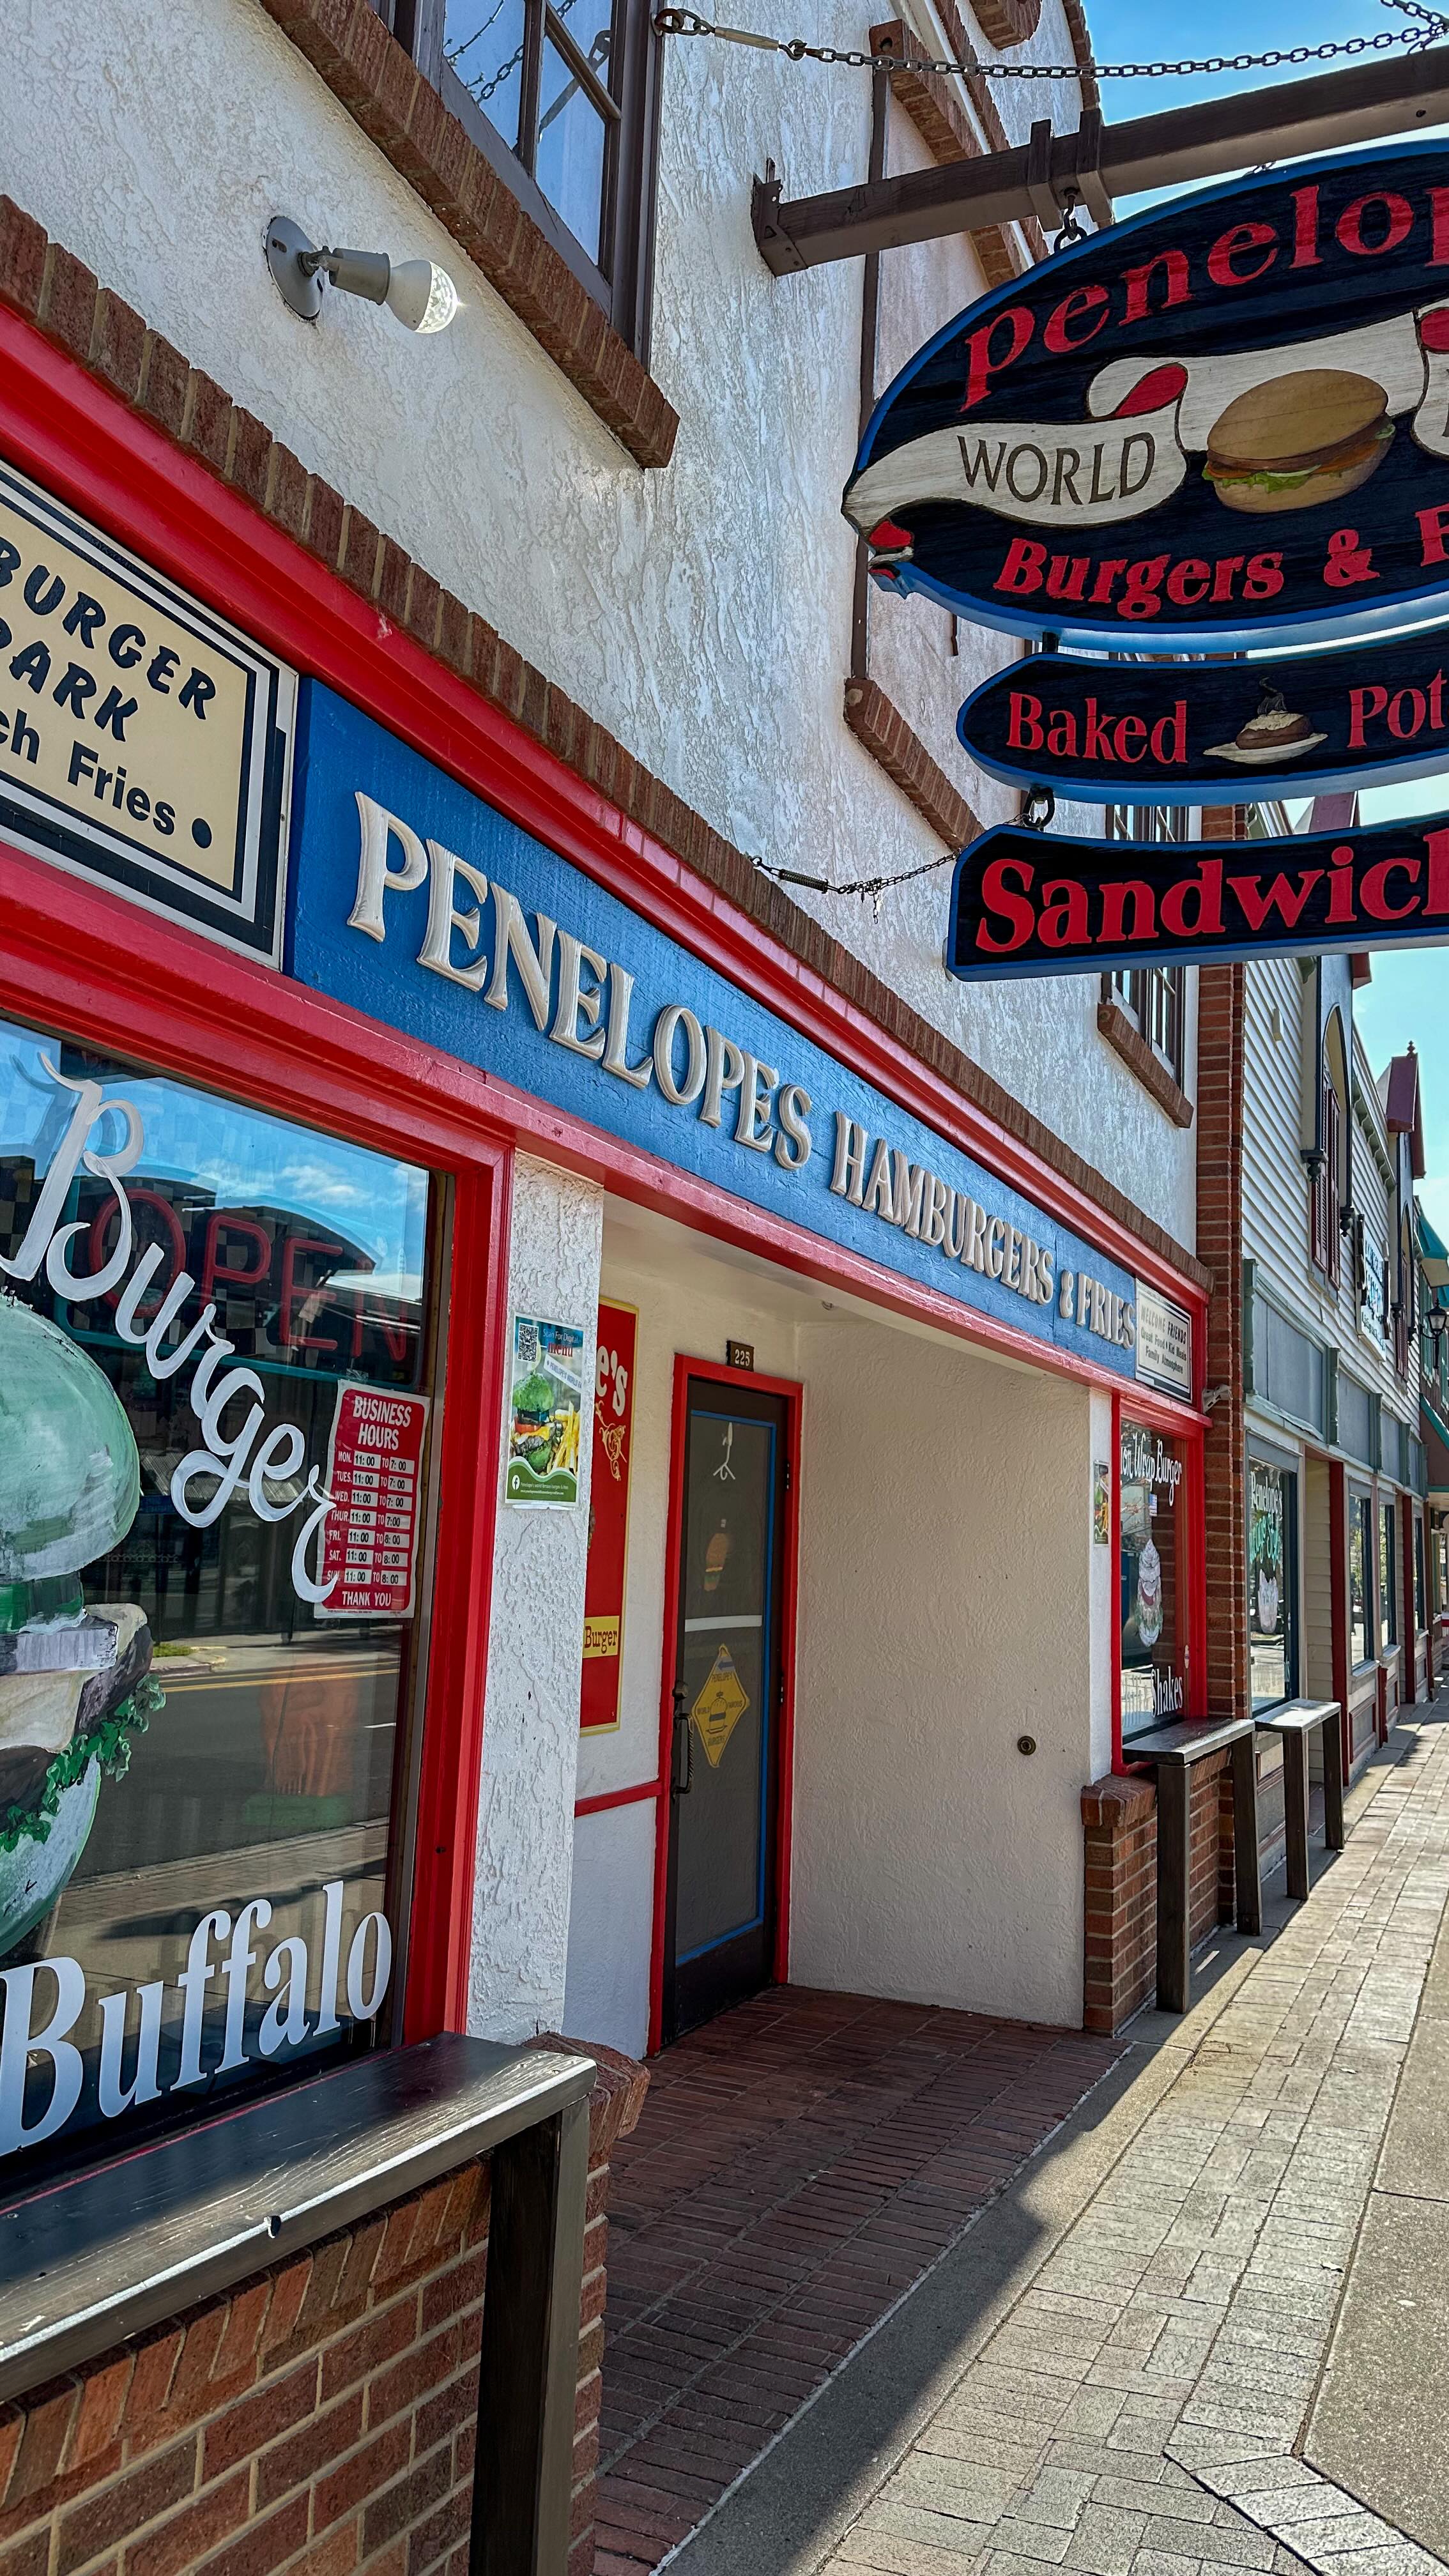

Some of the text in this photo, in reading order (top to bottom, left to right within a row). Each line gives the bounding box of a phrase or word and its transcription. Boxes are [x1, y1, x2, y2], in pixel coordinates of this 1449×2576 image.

[957, 433, 1154, 507] WORLD
[994, 537, 1284, 620] Burgers
[1323, 529, 1381, 587] &
[0, 537, 217, 720] BURGER
[1007, 669, 1447, 763] Baked Pot
[68, 740, 176, 836] Fries
[347, 791, 813, 1171] PENELOPES
[830, 1111, 1053, 1305] HAMBURGERS
[1076, 1272, 1135, 1349] FRIES
[0, 1052, 337, 1604] Burger
[564, 1333, 578, 1344] Digital
[1141, 1305, 1186, 1344] WELCOME FRIENDS
[1141, 1327, 1153, 1343] Great
[1155, 1334, 1165, 1349] Food
[735, 1349, 750, 1367] 225
[1146, 1346, 1160, 1364] Family
[595, 1346, 628, 1416] e's
[353, 1395, 411, 1427] BUSINESS
[358, 1423, 399, 1450] HOURS
[338, 1451, 351, 1462] MON.
[382, 1457, 388, 1468] TO
[1133, 1432, 1155, 1492] Wrap
[1155, 1439, 1182, 1506] Burger
[337, 1471, 352, 1482] TUES.
[380, 1476, 387, 1487] TO
[335, 1491, 349, 1502] WED.
[379, 1496, 386, 1506] TO
[331, 1510, 349, 1521] THUR.
[378, 1515, 384, 1524] TO
[328, 1530, 341, 1541] FRI.
[376, 1533, 383, 1544] TO
[329, 1550, 341, 1561] SAT.
[374, 1553, 381, 1563] TO
[373, 1572, 379, 1582] TO
[342, 1591, 391, 1606] THANK YOU
[585, 1625, 617, 1654] Burger
[1151, 1666, 1183, 1717] Shakes
[0, 1880, 392, 2156] Buffalo
